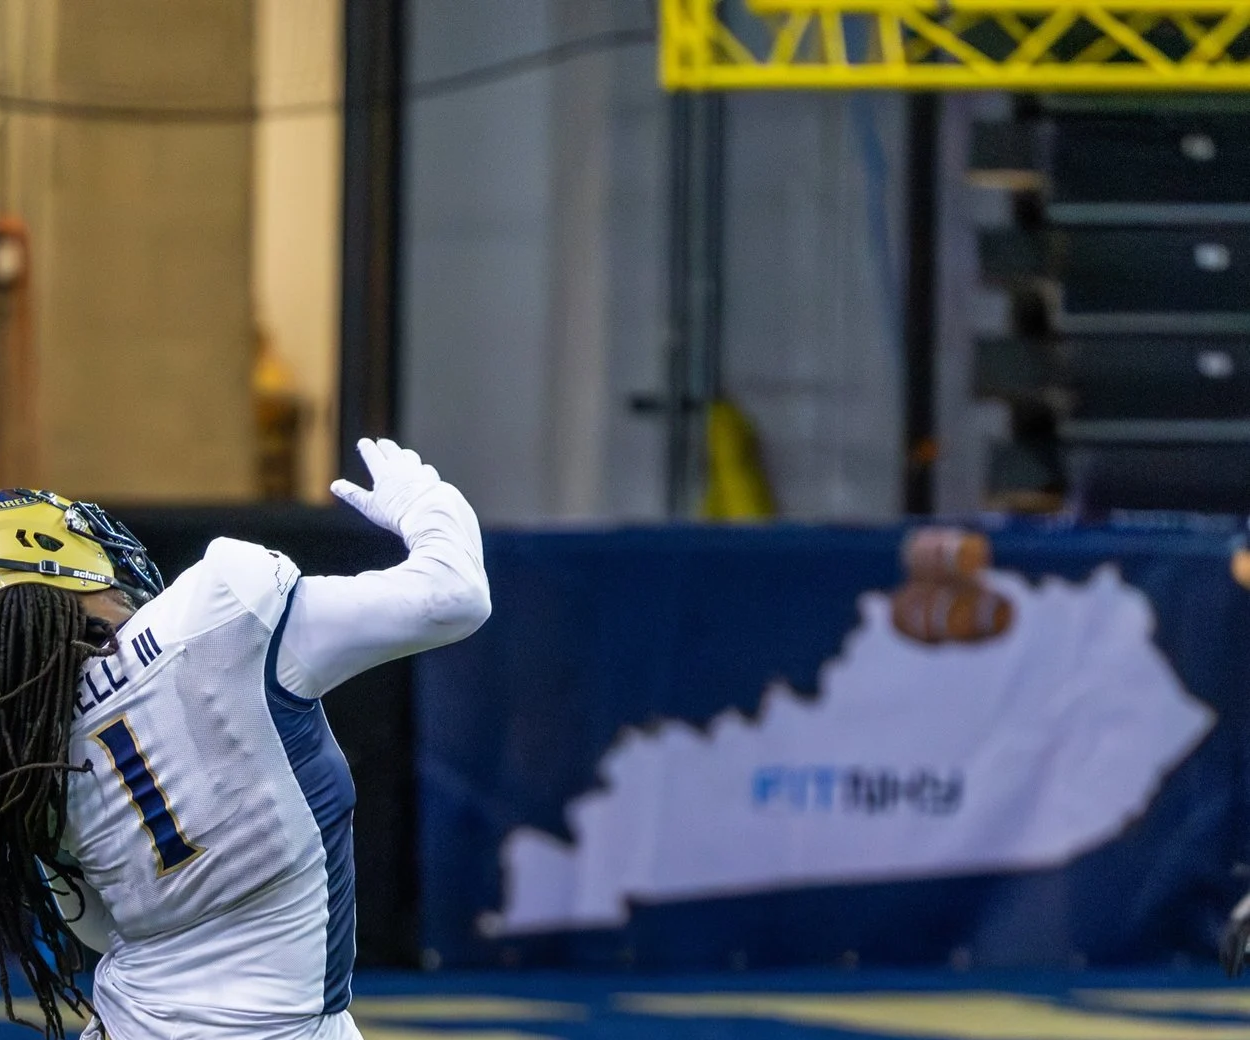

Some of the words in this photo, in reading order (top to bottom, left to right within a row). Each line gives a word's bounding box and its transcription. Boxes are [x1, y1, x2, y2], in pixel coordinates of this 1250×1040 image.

[73, 569, 106, 583] schutt
[74, 658, 129, 716] ELL
[131, 626, 163, 668] III
[89, 713, 207, 879] 1
